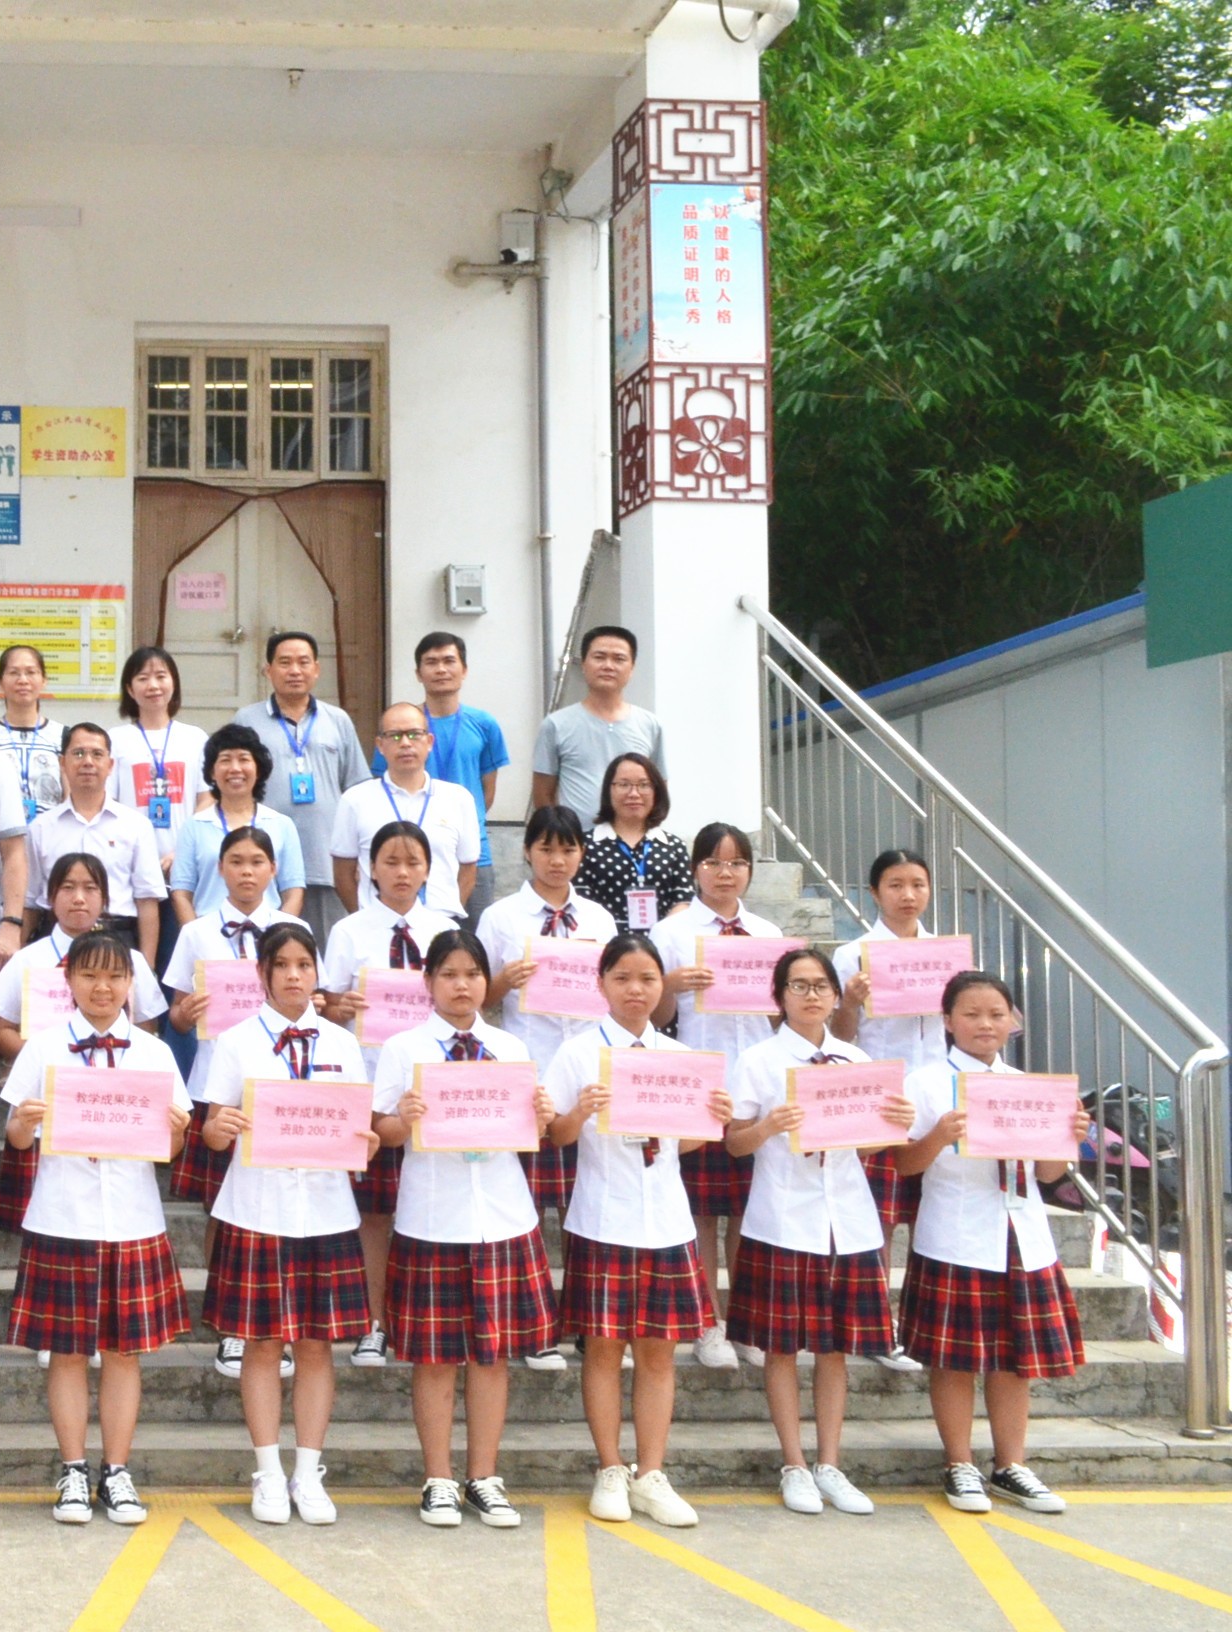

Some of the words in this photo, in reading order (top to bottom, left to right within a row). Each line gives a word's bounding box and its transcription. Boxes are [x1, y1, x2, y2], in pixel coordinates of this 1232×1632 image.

[682, 204, 700, 324] 品质证明优秀
[714, 204, 732, 324] 以健康的人格
[32, 448, 115, 462] 学生资助办公室
[889, 960, 952, 974] 教学成果奖金
[575, 980, 592, 991] 200
[750, 976, 768, 986] 200
[920, 976, 936, 988] 200
[632, 1073, 702, 1089] 教学成果奖金
[76, 1091, 150, 1108] 教学成果奖金
[440, 1088, 511, 1102] 教学成果奖金
[664, 1094, 682, 1104] 200
[816, 1084, 884, 1101] 教学成果奖金
[848, 1102, 866, 1114] 200
[987, 1098, 1056, 1113] 教学成果奖金
[108, 1112, 128, 1124] 200
[275, 1105, 348, 1121] 教学成果奖金
[471, 1108, 491, 1118] 200
[1020, 1118, 1038, 1128] 200
[307, 1126, 326, 1136] 200
